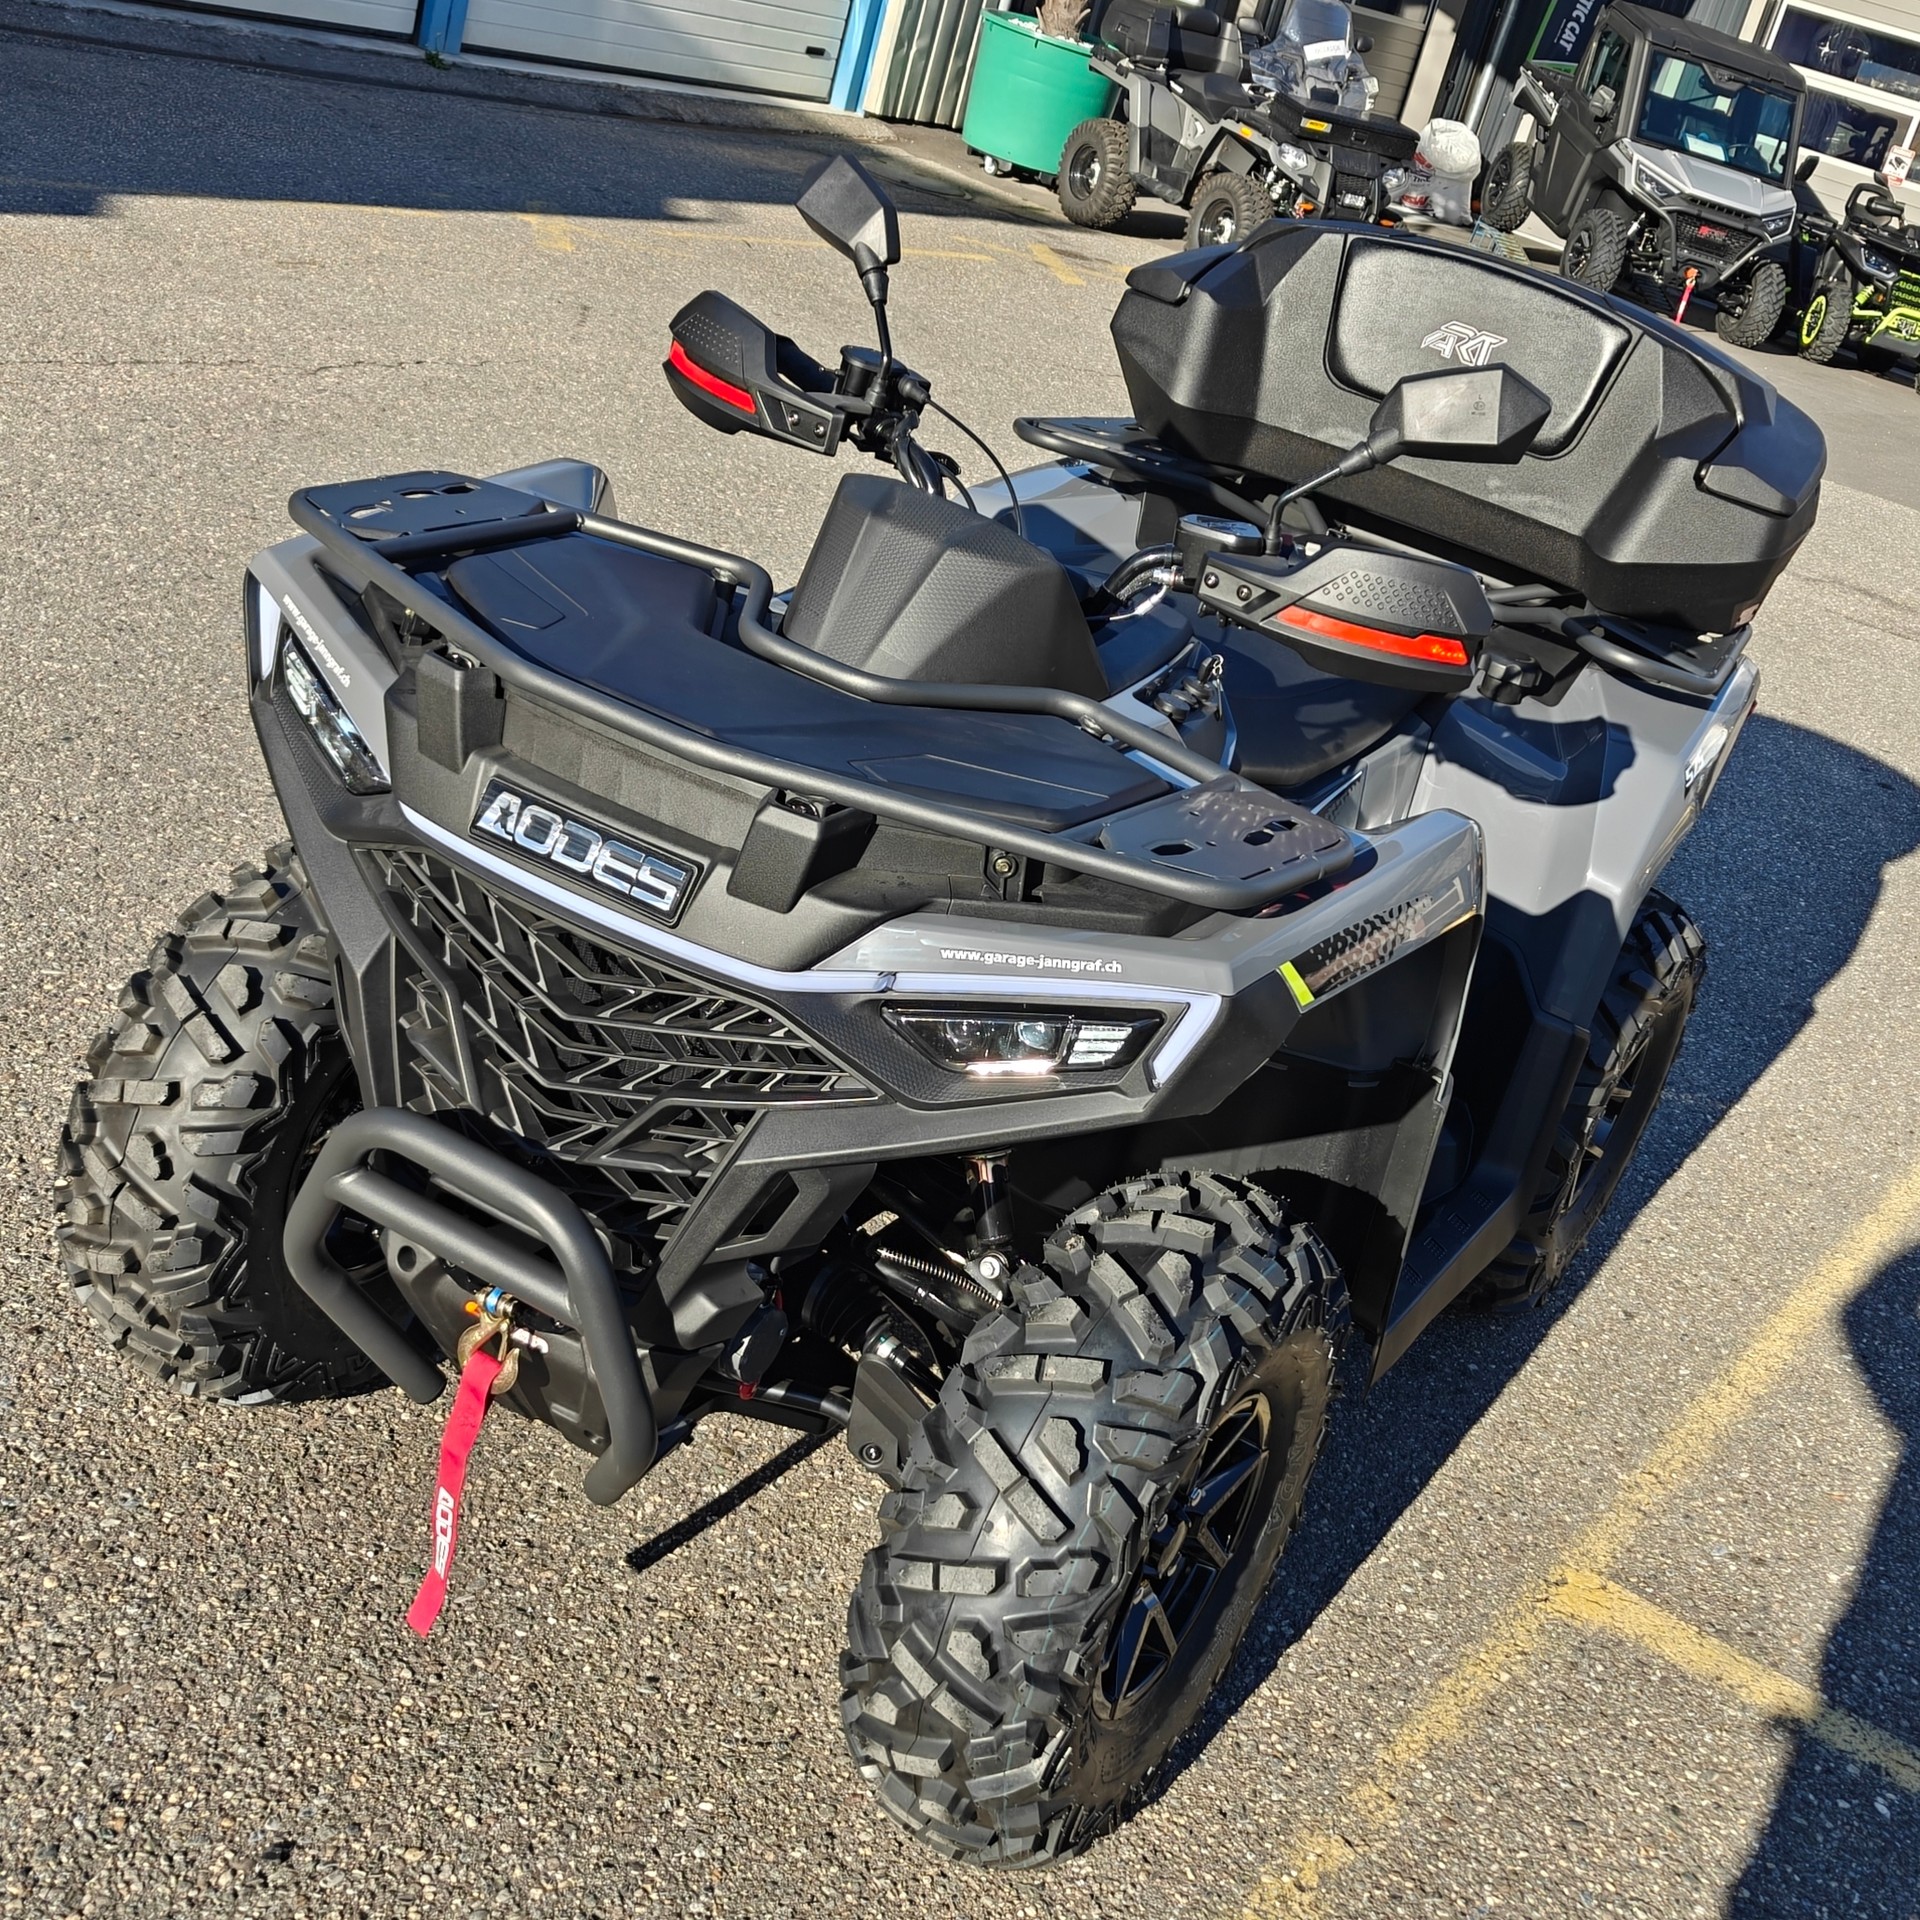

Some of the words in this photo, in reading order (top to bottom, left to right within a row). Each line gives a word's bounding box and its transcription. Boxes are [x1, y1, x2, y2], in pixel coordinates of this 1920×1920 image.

[1559, 21, 1580, 52] CAT
[476, 790, 687, 912] AODES
[940, 948, 1122, 973] www.garage-janngraf.ch
[434, 1486, 455, 1581] AODES
